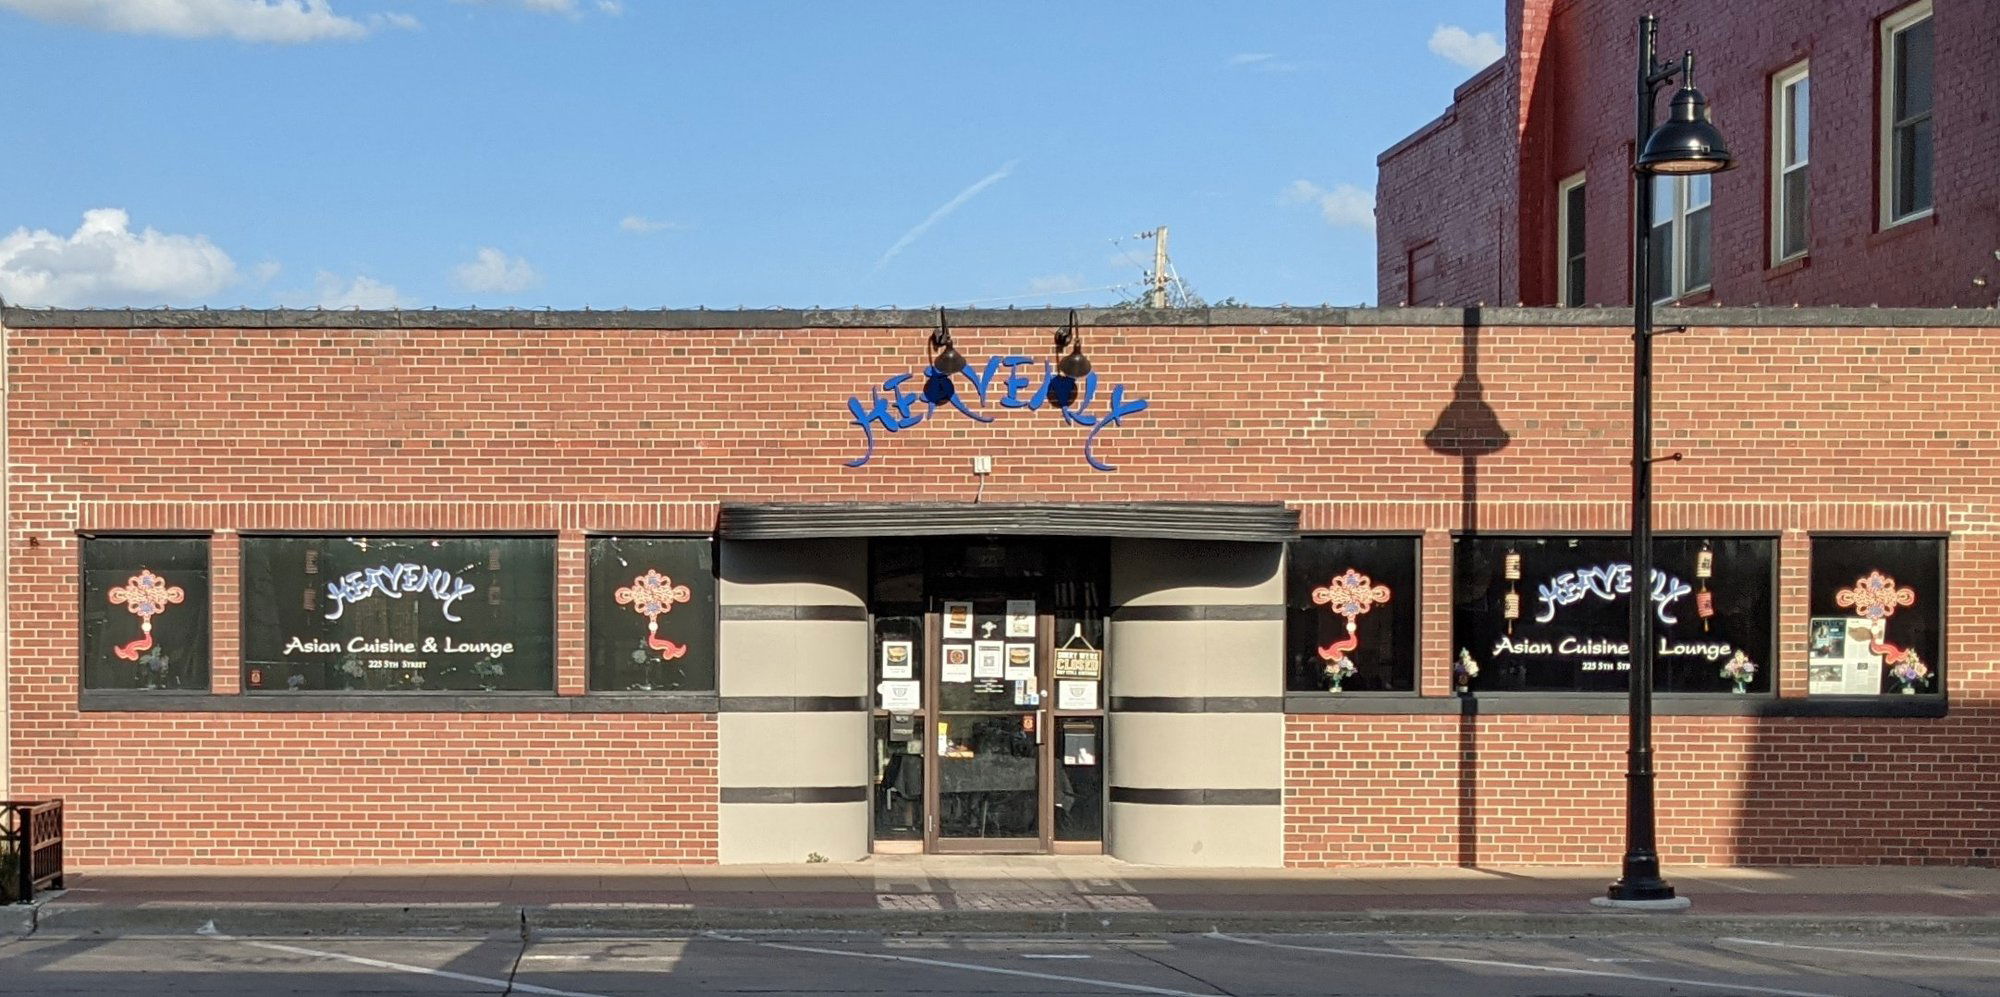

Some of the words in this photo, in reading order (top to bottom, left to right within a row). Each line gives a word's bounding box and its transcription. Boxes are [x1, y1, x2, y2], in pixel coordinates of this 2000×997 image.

[842, 355, 1149, 472] HEAVENLY
[324, 562, 476, 623] HEAVENLY
[1535, 563, 1692, 625] HEAVELY
[283, 636, 342, 655] Asian
[347, 636, 417, 654] Cuisine
[421, 636, 438, 654] &
[444, 636, 514, 659] Lounge
[1492, 635, 1553, 657] Asian
[1558, 637, 1631, 655] Cuisine
[1658, 637, 1732, 660] Lounge
[368, 660, 382, 669] 225
[1056, 658, 1099, 672] CLOSED
[1581, 661, 1596, 671] 225
